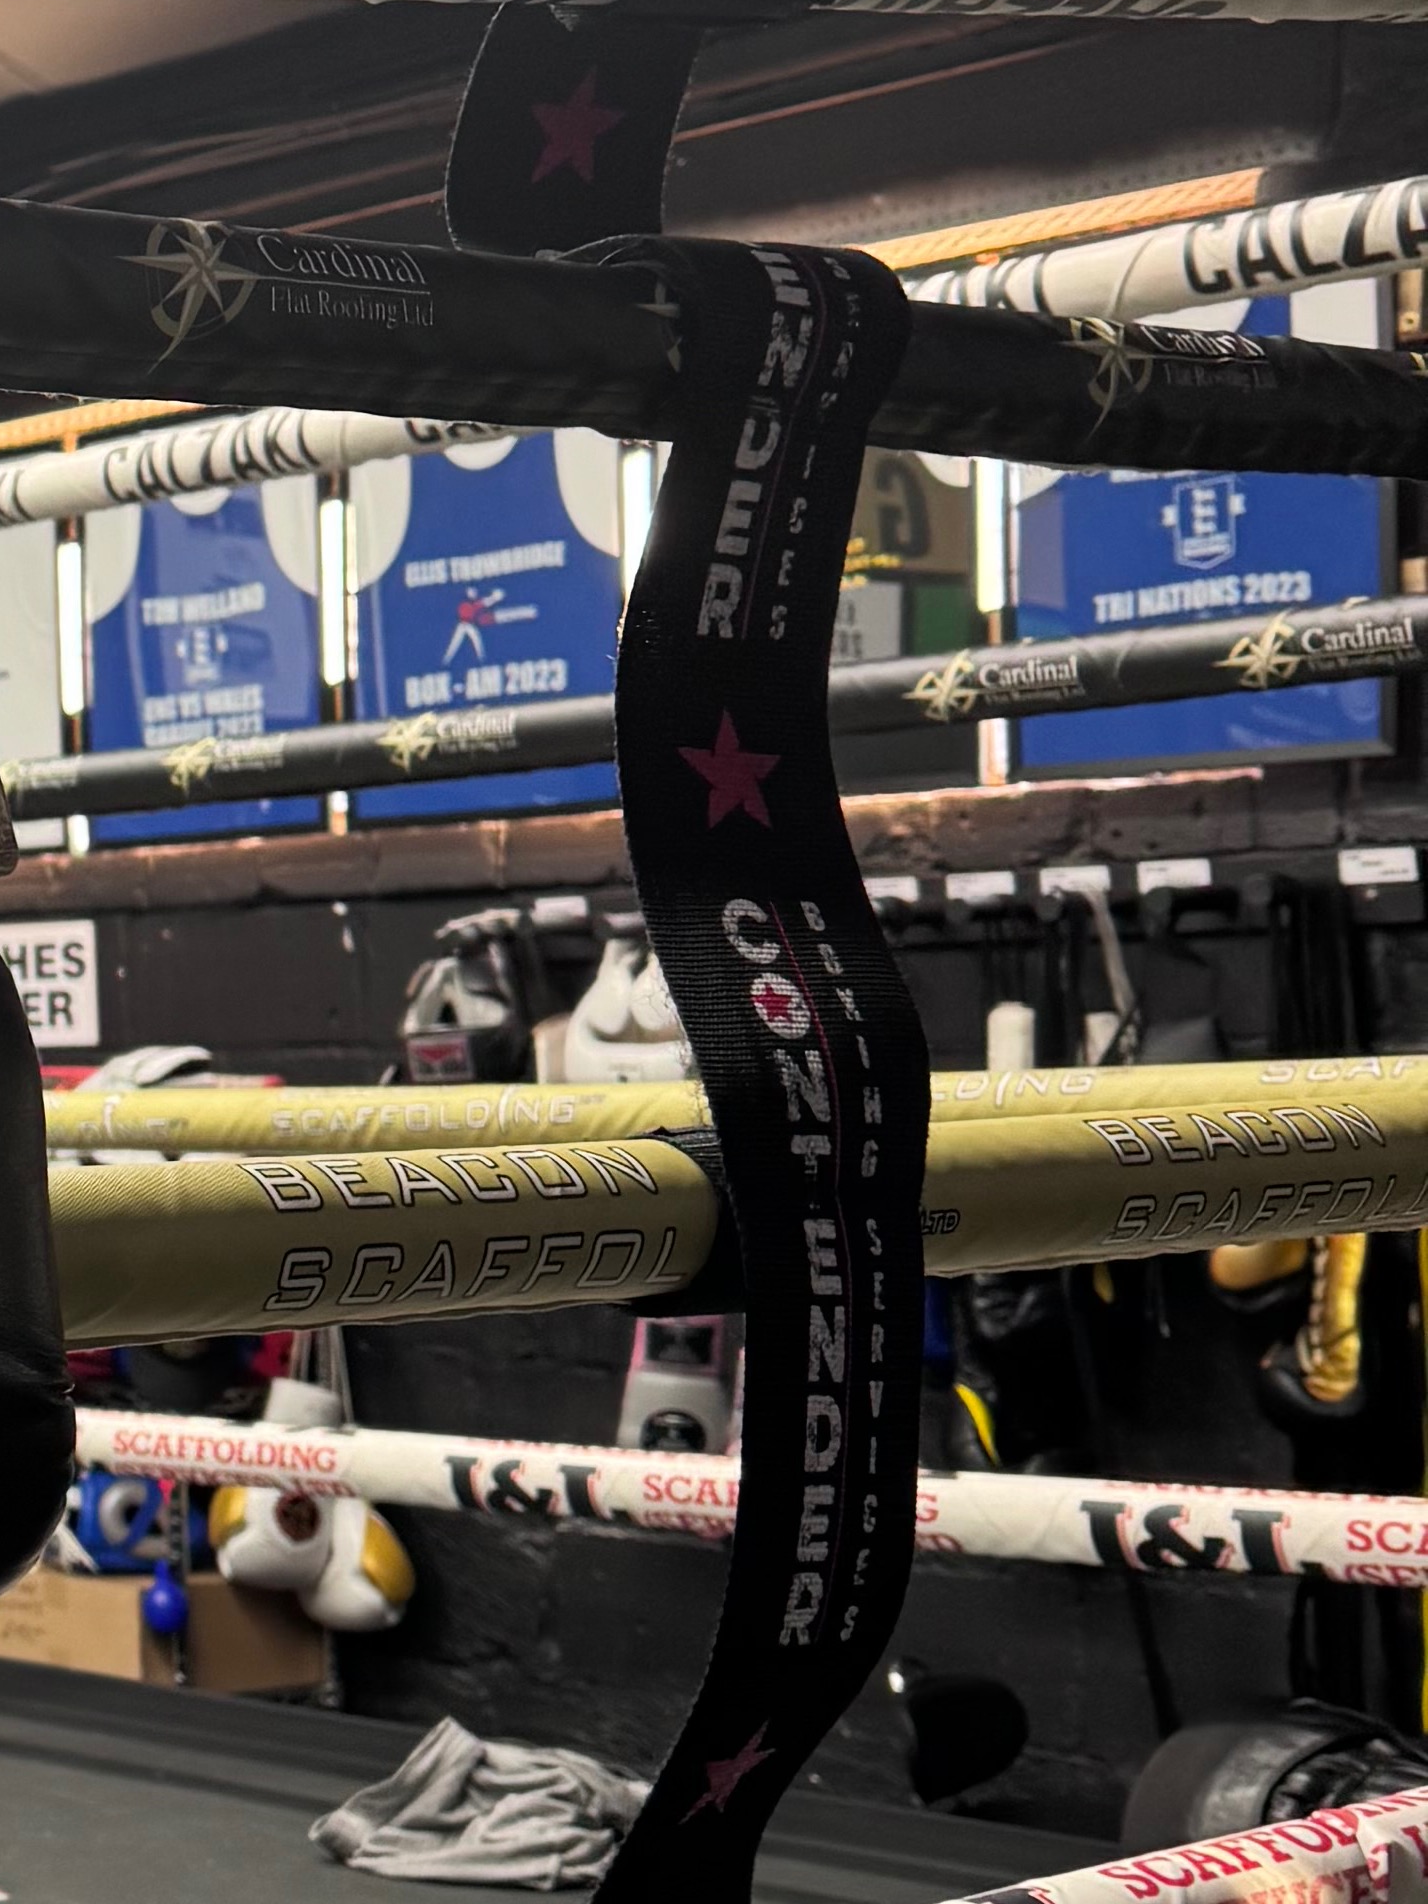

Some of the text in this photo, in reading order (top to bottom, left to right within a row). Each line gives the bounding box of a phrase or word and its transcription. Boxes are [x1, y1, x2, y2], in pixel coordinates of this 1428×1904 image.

[256, 233, 427, 286] Cardinal
[317, 290, 398, 330] Roofing
[402, 298, 435, 328] Ltd
[1137, 575, 1241, 613] NATIONS
[1242, 570, 1313, 605] 2023
[1300, 616, 1416, 655] Cardinal
[978, 654, 1078, 690] Cardinal
[2, 942, 86, 980] HES
[1086, 1102, 1386, 1167] BEACON
[240, 1139, 660, 1214] BEACON
[721, 898, 847, 1647] CONTENDER
[111, 1427, 339, 1475] SCAFFOLDING
